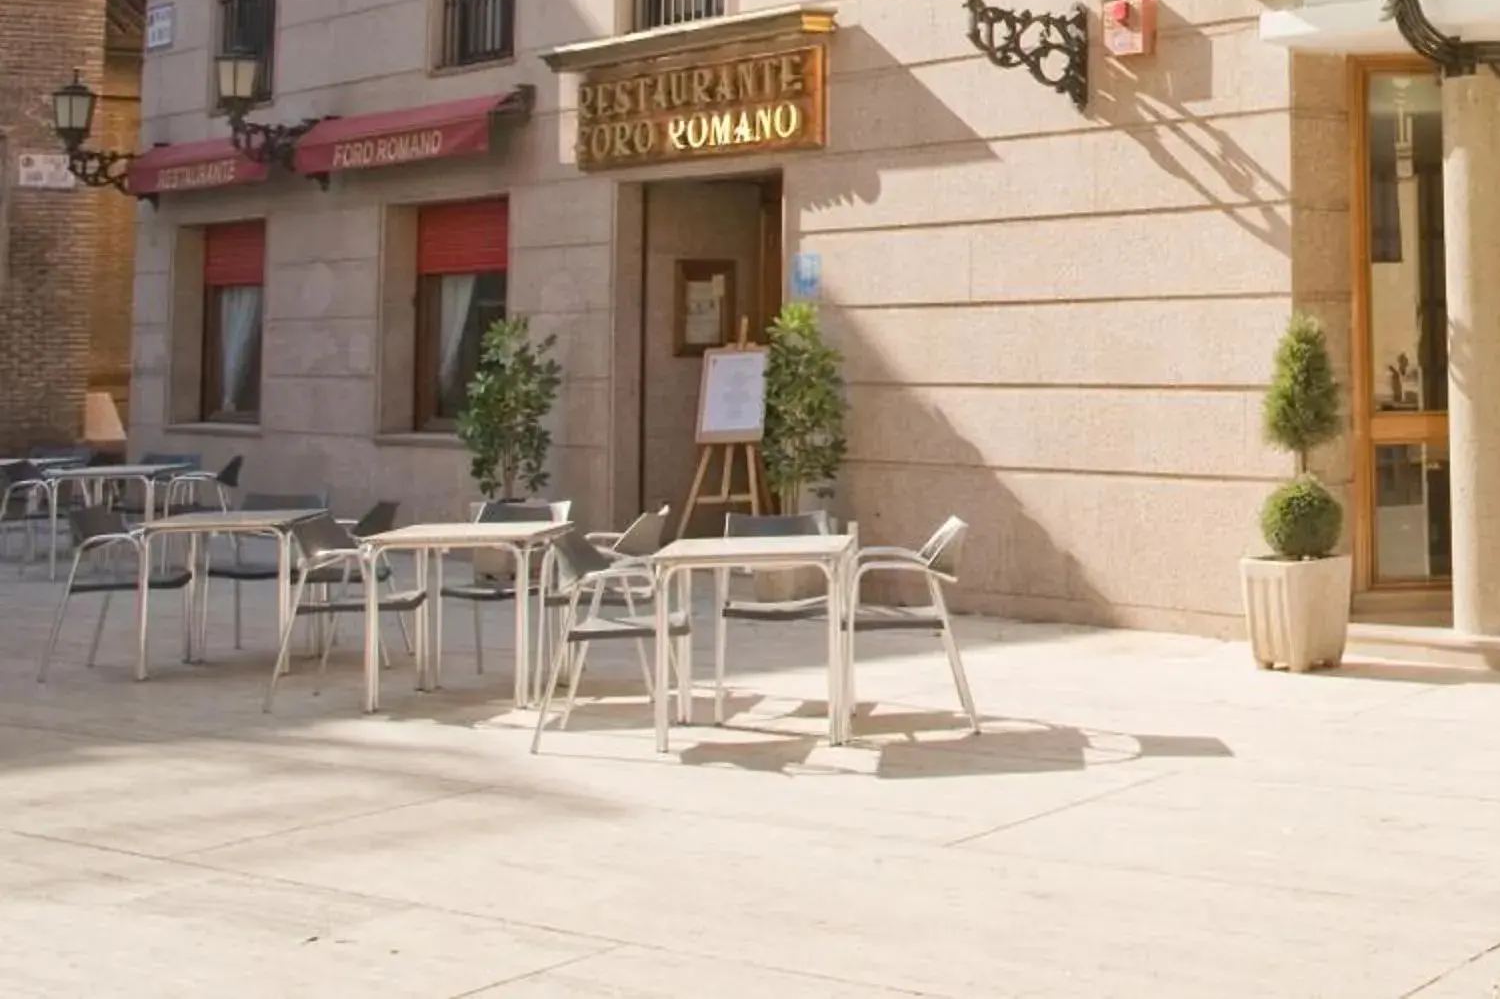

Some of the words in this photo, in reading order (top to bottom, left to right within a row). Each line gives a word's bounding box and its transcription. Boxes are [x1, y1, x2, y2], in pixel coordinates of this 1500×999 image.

[578, 56, 802, 119] RESTAURANTE
[668, 102, 797, 150] ROMANO
[332, 140, 375, 169] FORO
[376, 129, 442, 162] ROMANO
[157, 159, 236, 191] RESTAURANTE
